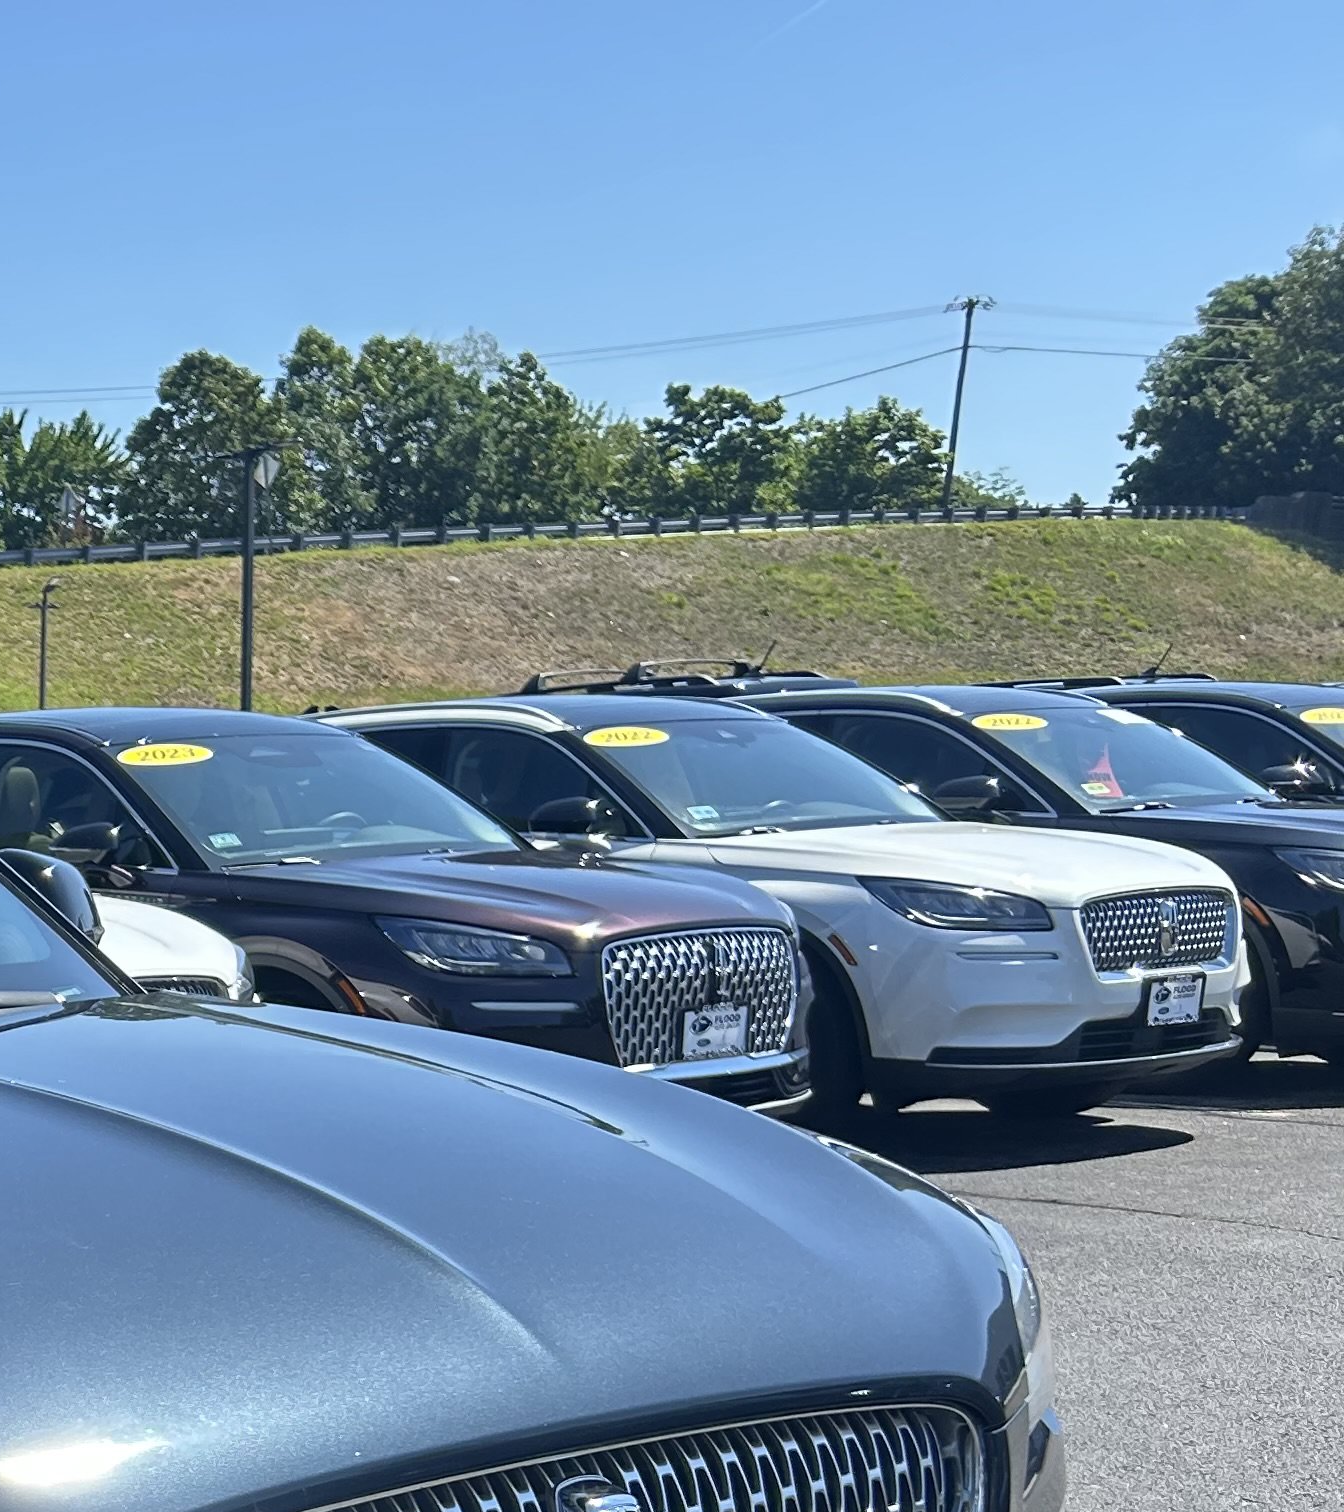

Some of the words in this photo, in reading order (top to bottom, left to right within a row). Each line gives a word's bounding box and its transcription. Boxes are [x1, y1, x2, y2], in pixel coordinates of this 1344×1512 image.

[600, 731, 651, 743] 2022
[136, 748, 196, 761] 2023
[714, 1013, 741, 1024] FLOOD
